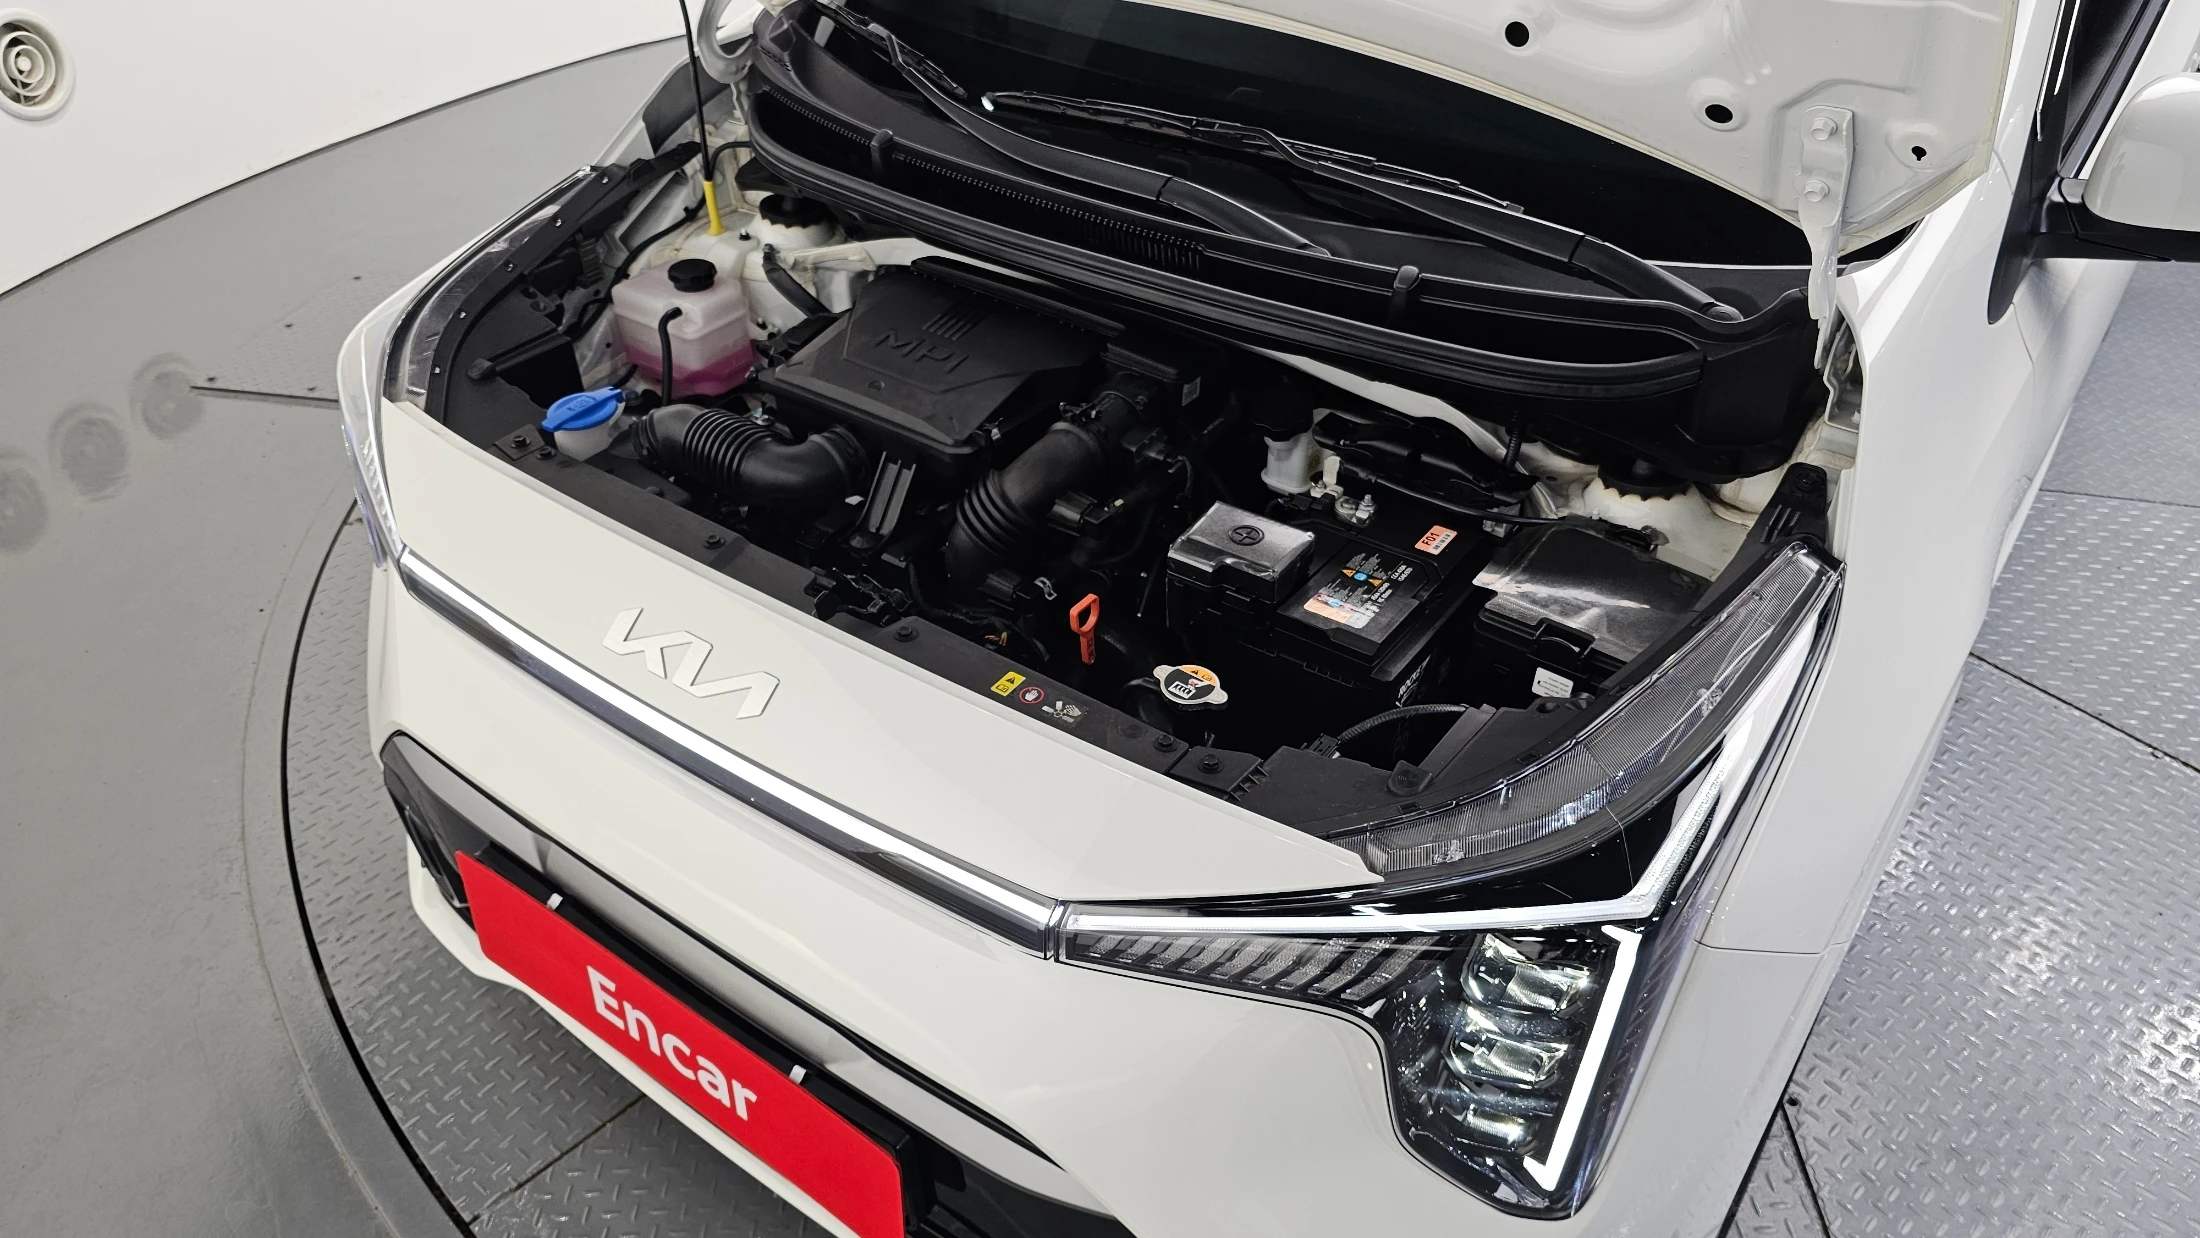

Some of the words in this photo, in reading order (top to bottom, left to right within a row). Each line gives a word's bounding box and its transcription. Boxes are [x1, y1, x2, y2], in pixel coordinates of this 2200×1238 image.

[872, 327, 970, 375] MPI
[1421, 532, 1440, 546] F01
[602, 607, 780, 719] KIA
[586, 965, 758, 1121] Encar
